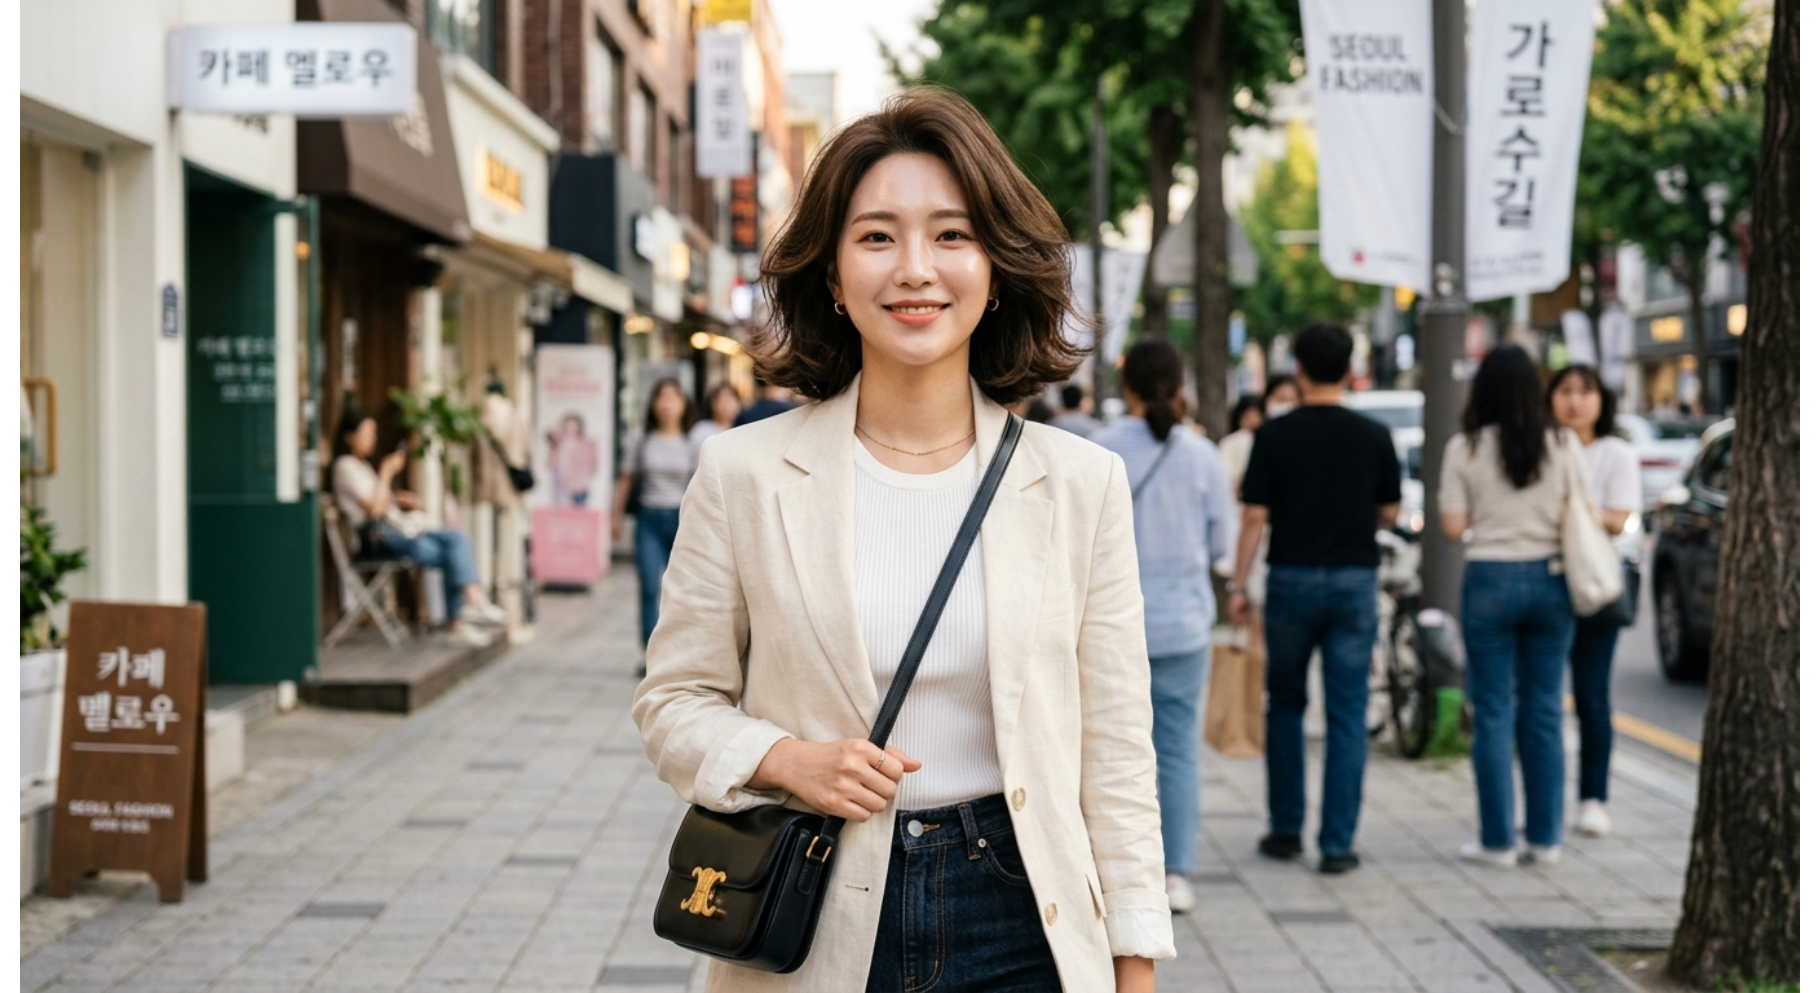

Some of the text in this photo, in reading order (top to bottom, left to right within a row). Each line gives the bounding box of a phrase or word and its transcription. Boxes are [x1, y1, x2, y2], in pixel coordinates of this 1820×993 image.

[1329, 34, 1407, 60] SEOUL
[199, 50, 270, 86] 카페
[1320, 67, 1422, 94] FASHION
[1492, 20, 1554, 229] 가로수길
[97, 647, 165, 688] 카페
